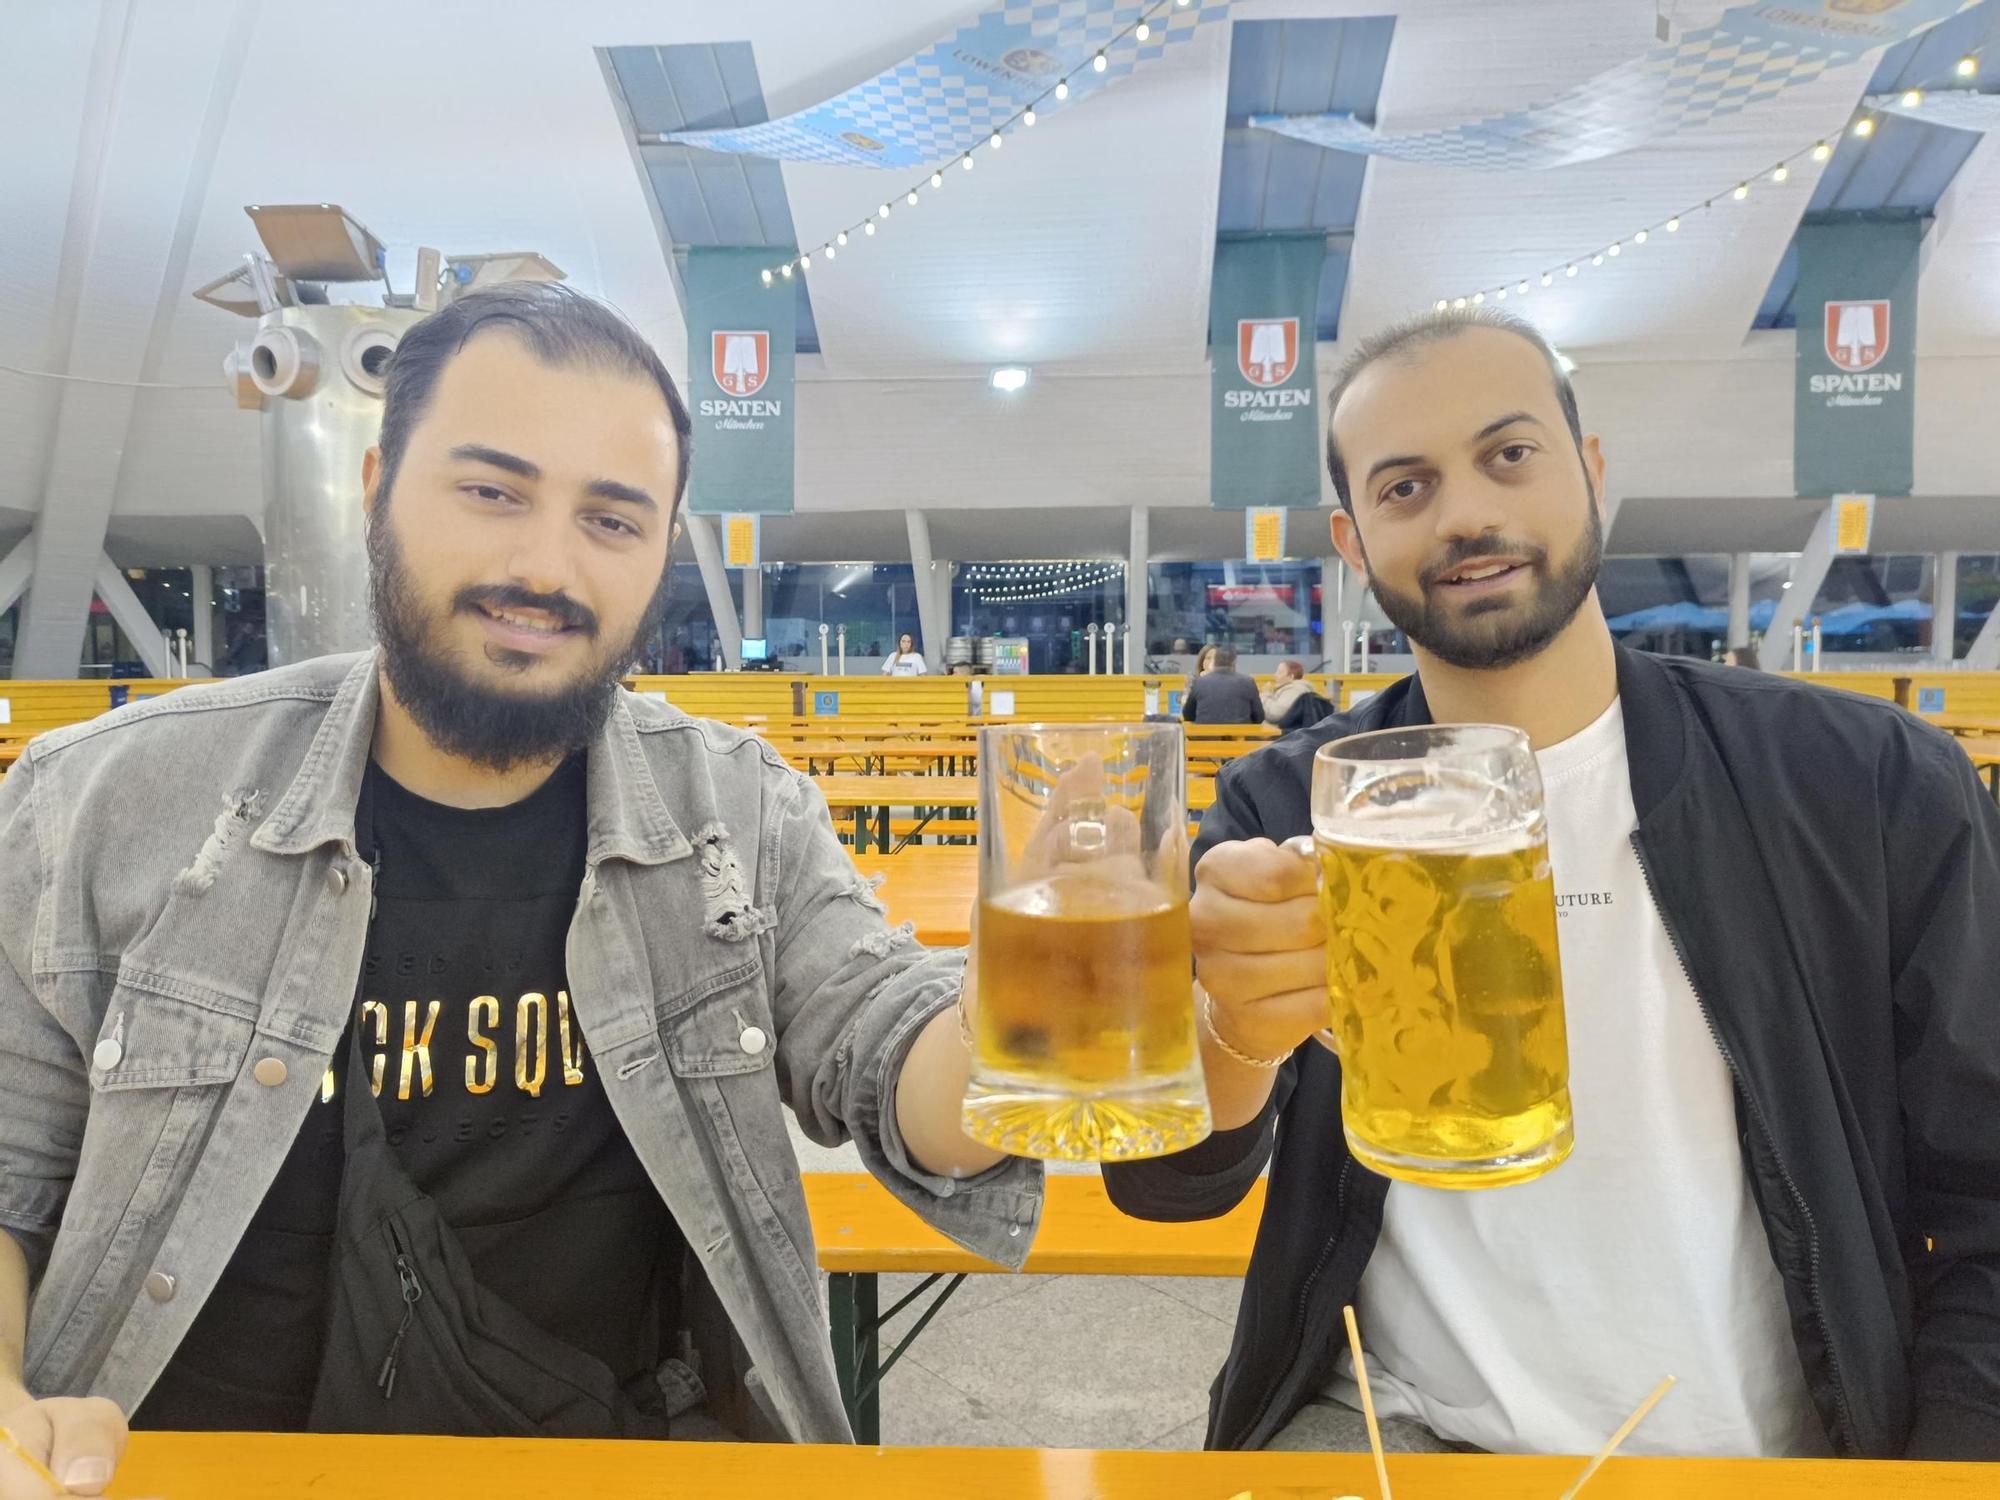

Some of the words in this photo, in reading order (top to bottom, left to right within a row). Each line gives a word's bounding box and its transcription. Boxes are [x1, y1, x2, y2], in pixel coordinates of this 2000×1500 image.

[747, 375, 758, 387] S
[1809, 372, 1903, 393] SPATEN
[699, 399, 782, 416] SPATEN
[1223, 388, 1312, 408] SPATEN
[320, 998, 442, 1105] CK
